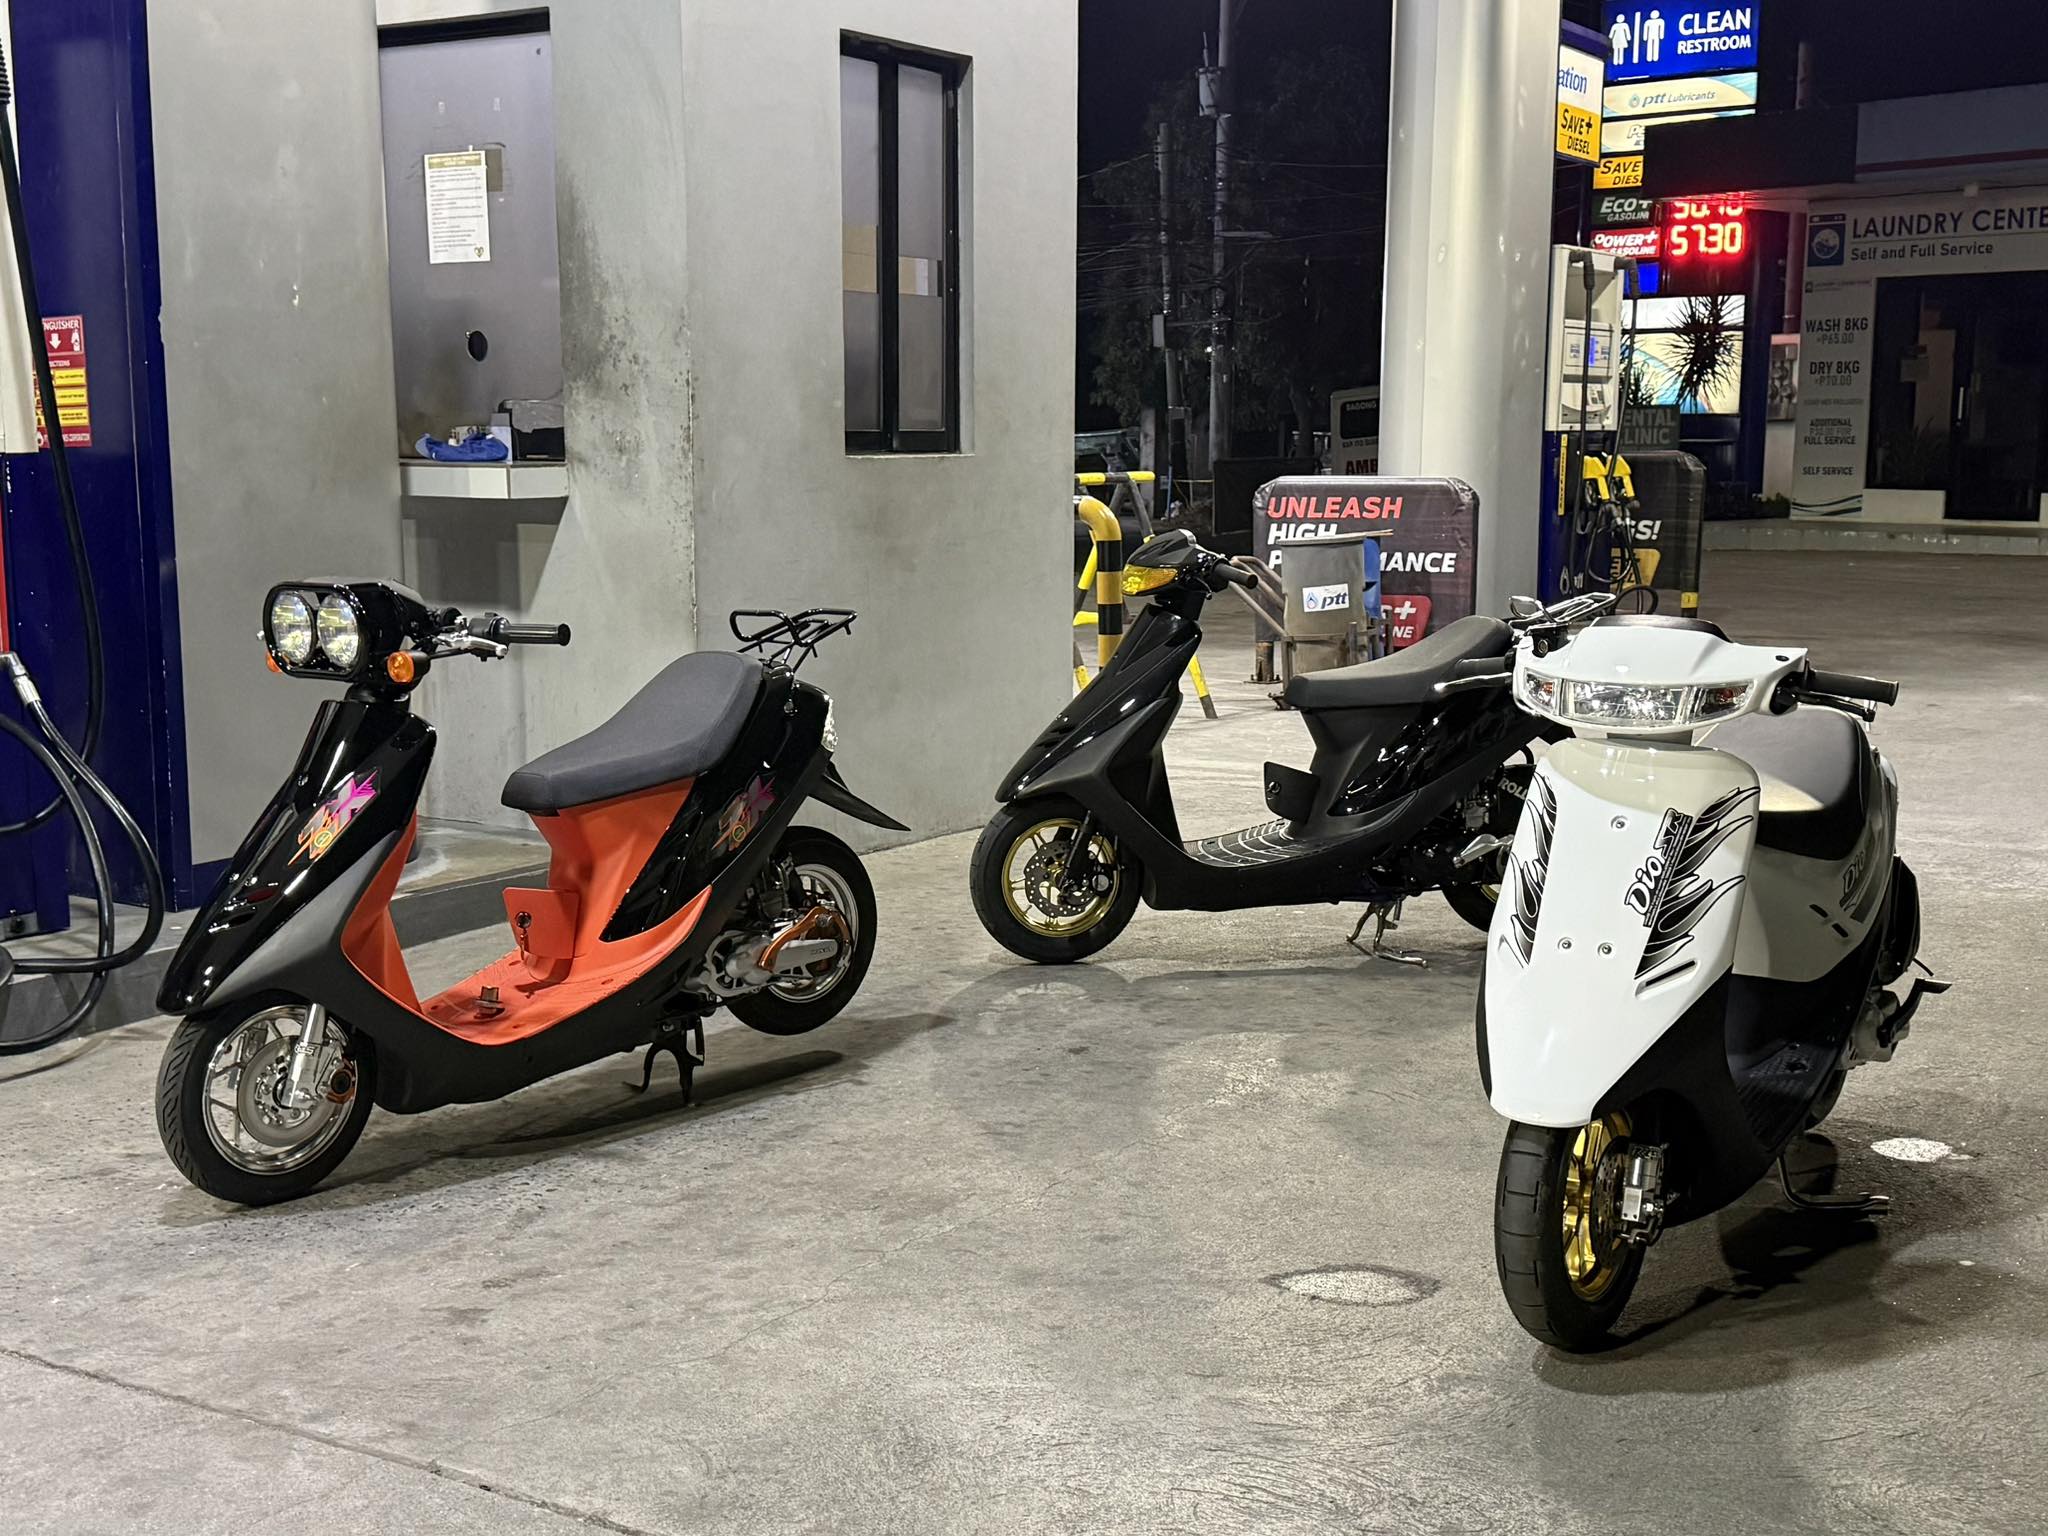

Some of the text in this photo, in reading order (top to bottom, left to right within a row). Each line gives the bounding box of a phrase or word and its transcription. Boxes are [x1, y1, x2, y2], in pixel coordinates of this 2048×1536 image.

[1678, 8, 1751, 36] CLEAN
[1677, 34, 1751, 54] RESTROOM
[1642, 90, 1716, 107] ptt Lubricants
[1567, 136, 1590, 155] DIESEL
[1852, 211, 1963, 239] LAUNDRY
[1850, 242, 1993, 261] Self and Full Service
[1805, 317, 1868, 333] WASH 8KG
[1809, 360, 1860, 375] DRY 8KG
[1804, 435, 1856, 445] FULL SERVICE
[1802, 466, 1854, 476] SELF SERVICE
[1267, 496, 1403, 519] UNLEASH
[1321, 592, 1347, 609] ptt
